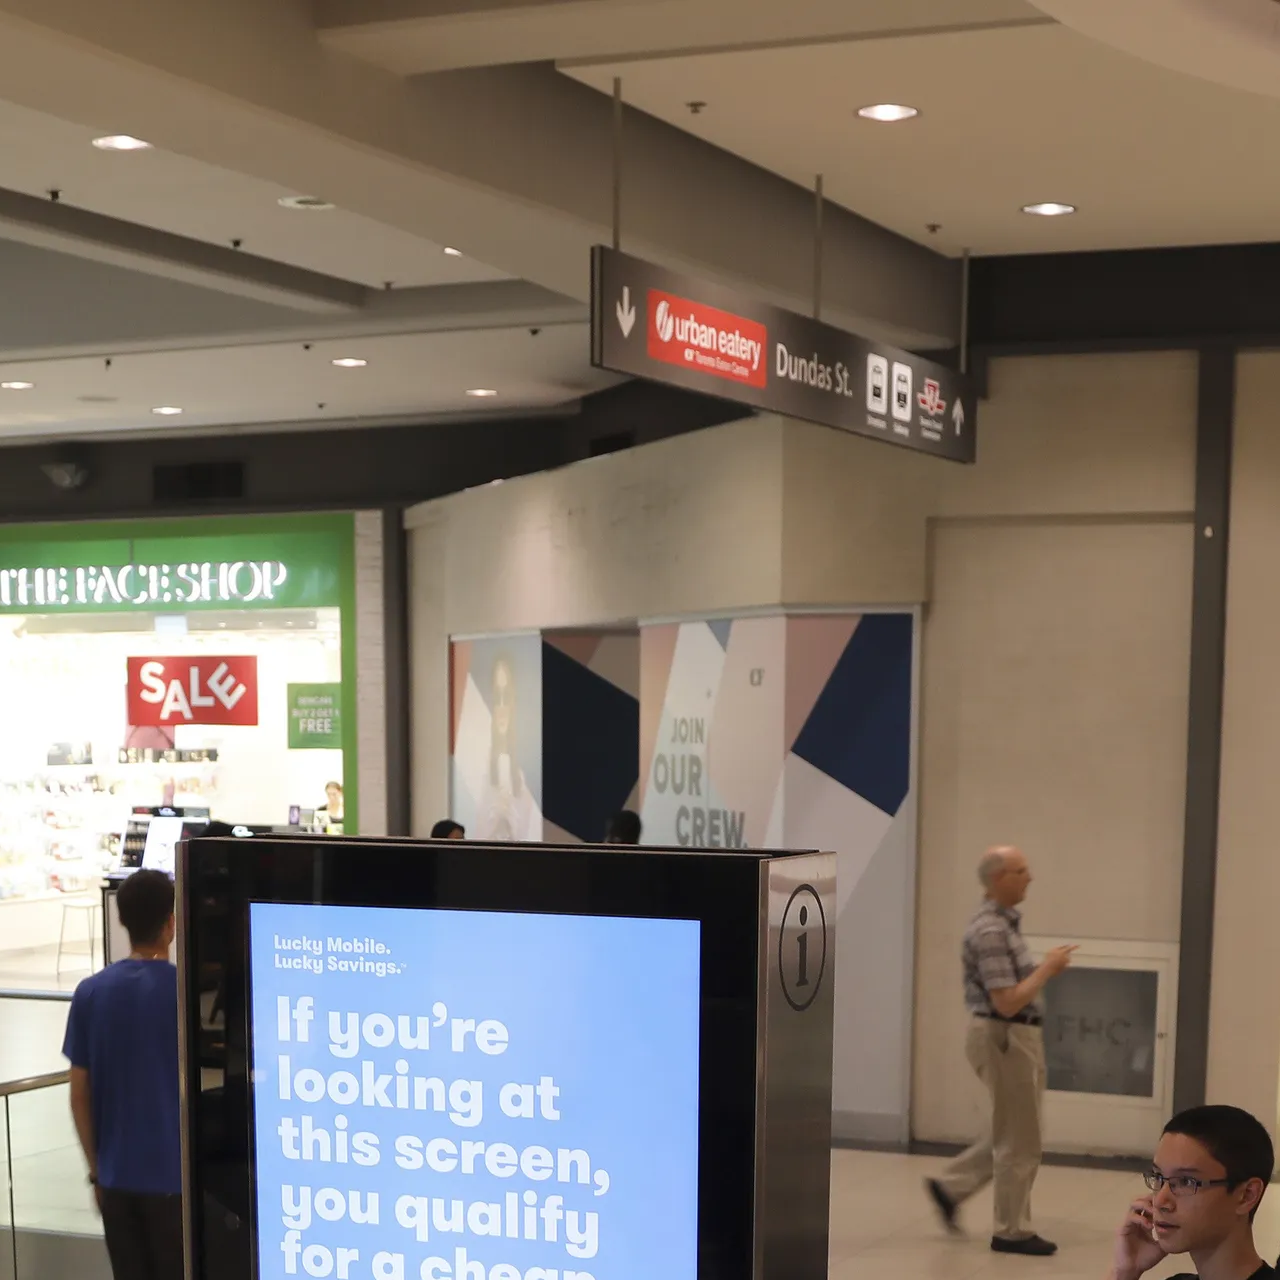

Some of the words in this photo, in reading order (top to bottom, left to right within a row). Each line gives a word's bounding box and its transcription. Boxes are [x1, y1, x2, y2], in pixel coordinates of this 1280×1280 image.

[675, 313, 718, 351] urban
[718, 330, 761, 371] eatery
[776, 342, 832, 391] Dundas
[835, 362, 853, 397] St.
[75, 563, 172, 604] FACE
[176, 560, 288, 602] SHOP
[140, 661, 246, 720] SALE
[299, 718, 332, 734] FREE
[671, 717, 704, 744] JOIN
[653, 753, 703, 796] OUR
[676, 805, 748, 848] CREW.
[274, 934, 323, 955] Lucky
[327, 937, 391, 954] Mobile.
[274, 953, 323, 974] Lucky
[277, 996, 314, 1042] If
[278, 1055, 483, 1127] looking
[499, 1076, 561, 1121] at
[277, 1114, 381, 1166] this
[394, 1133, 611, 1196] screen,
[281, 1184, 380, 1230] you
[395, 1190, 599, 1259] qualify
[280, 1229, 359, 1280] for
